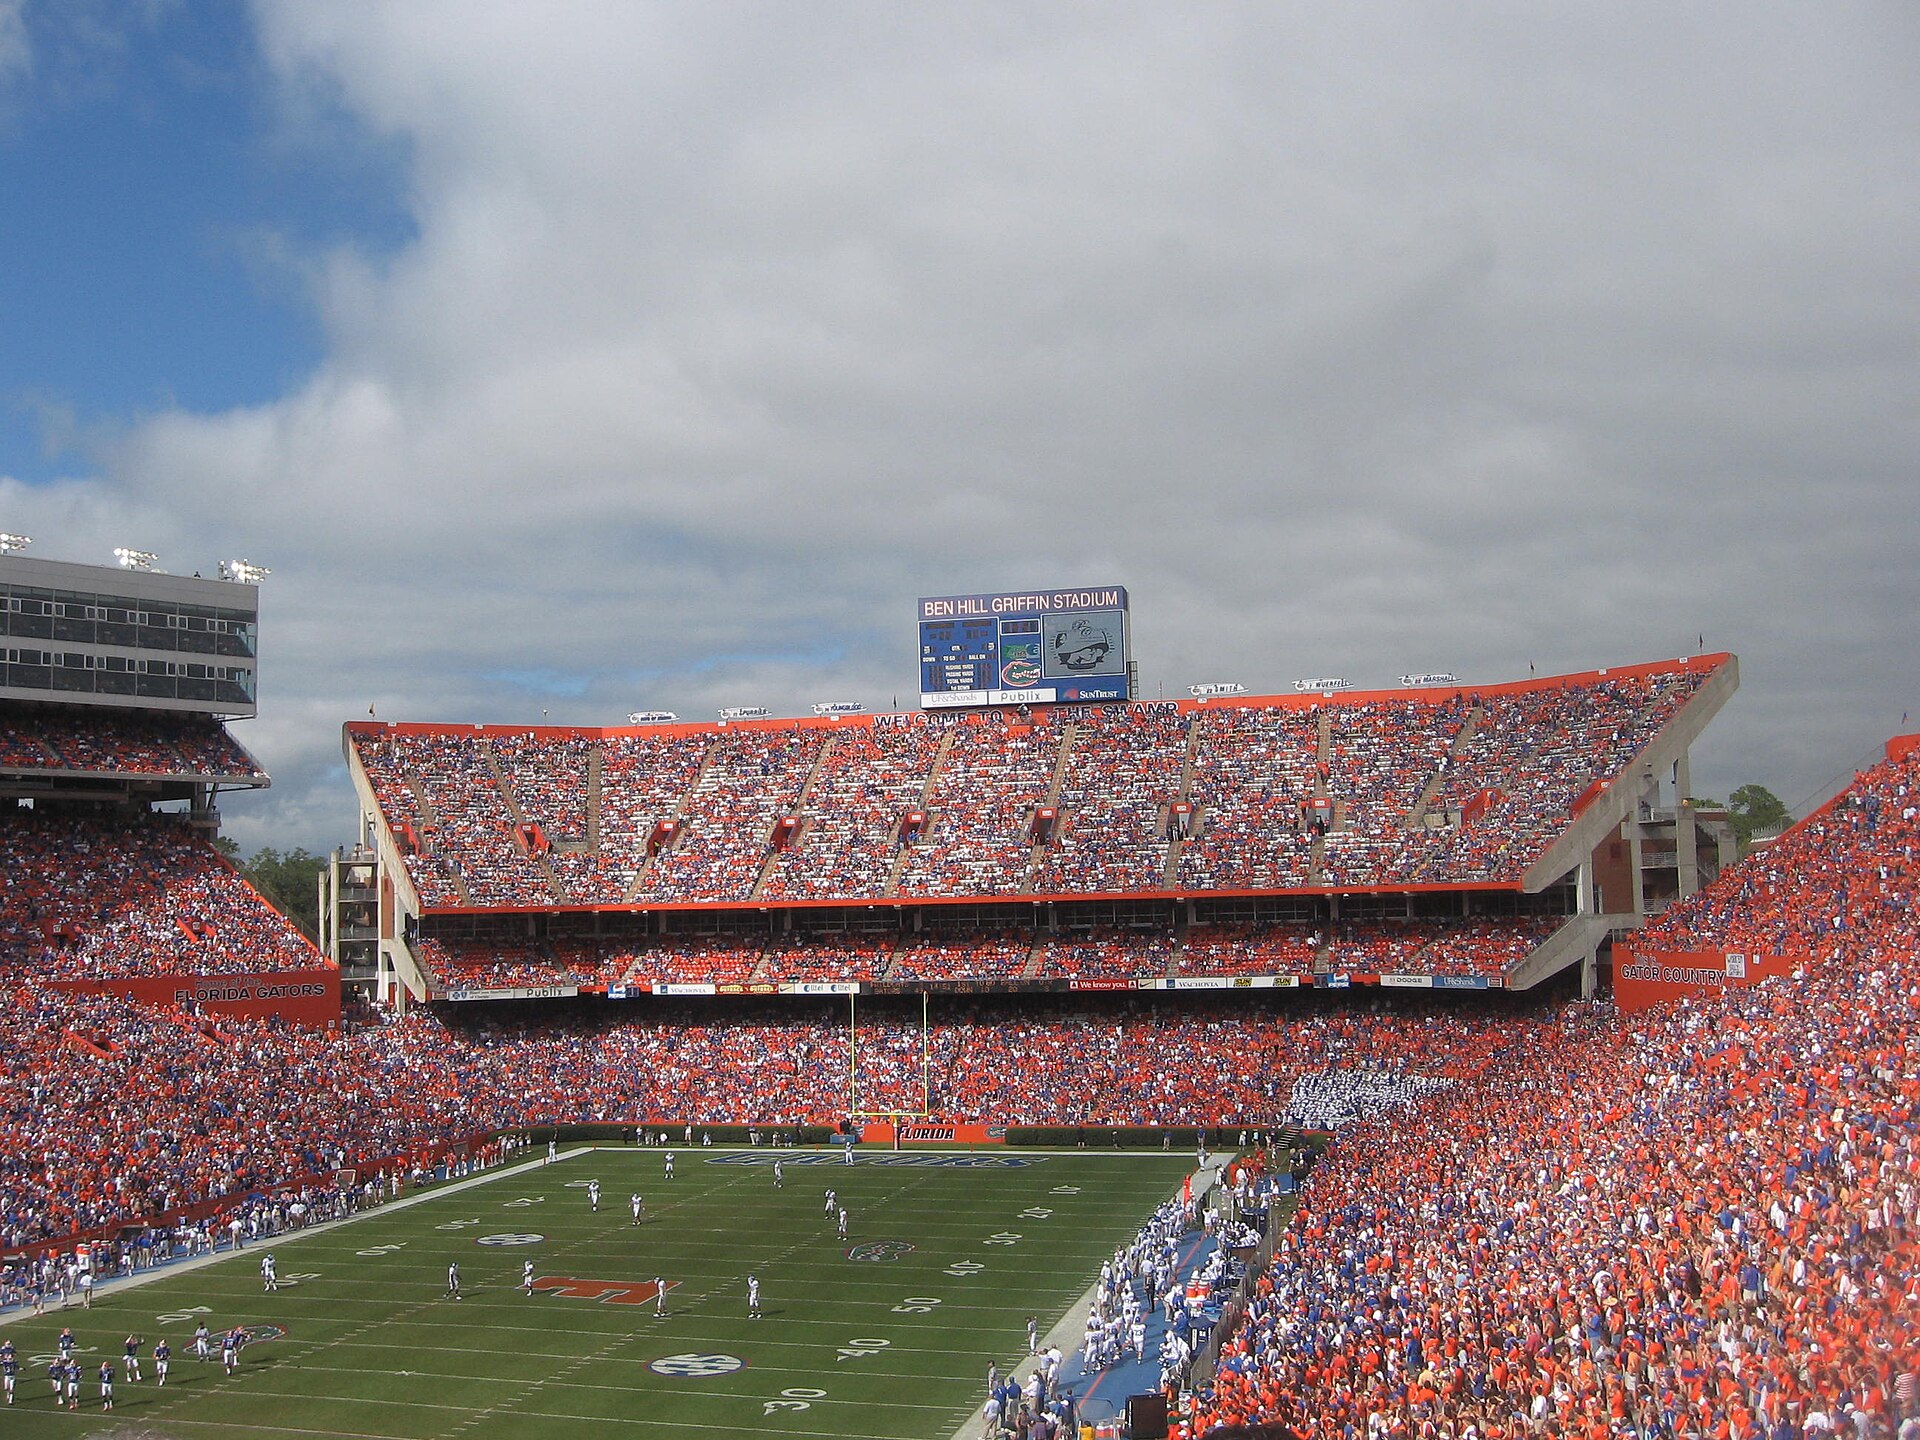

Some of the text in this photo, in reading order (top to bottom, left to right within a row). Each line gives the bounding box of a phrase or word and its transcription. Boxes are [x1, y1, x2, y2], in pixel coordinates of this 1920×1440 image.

[924, 591, 1118, 616] BEN HILL GRIFFIN STADIUM
[1001, 691, 1041, 701] Publix
[978, 710, 1004, 724] TO
[1053, 702, 1179, 720] THE SWAMP
[1621, 964, 1727, 987] GATOR COUNTRY
[174, 983, 325, 1003] FLORIDA GATORS
[526, 987, 563, 998] Publix
[1080, 981, 1092, 989] We
[1093, 980, 1110, 988] know
[900, 1125, 955, 1140] FLORIDA
[890, 1297, 942, 1313] 50
[836, 1338, 891, 1357] 40
[763, 1387, 828, 1412] 30
